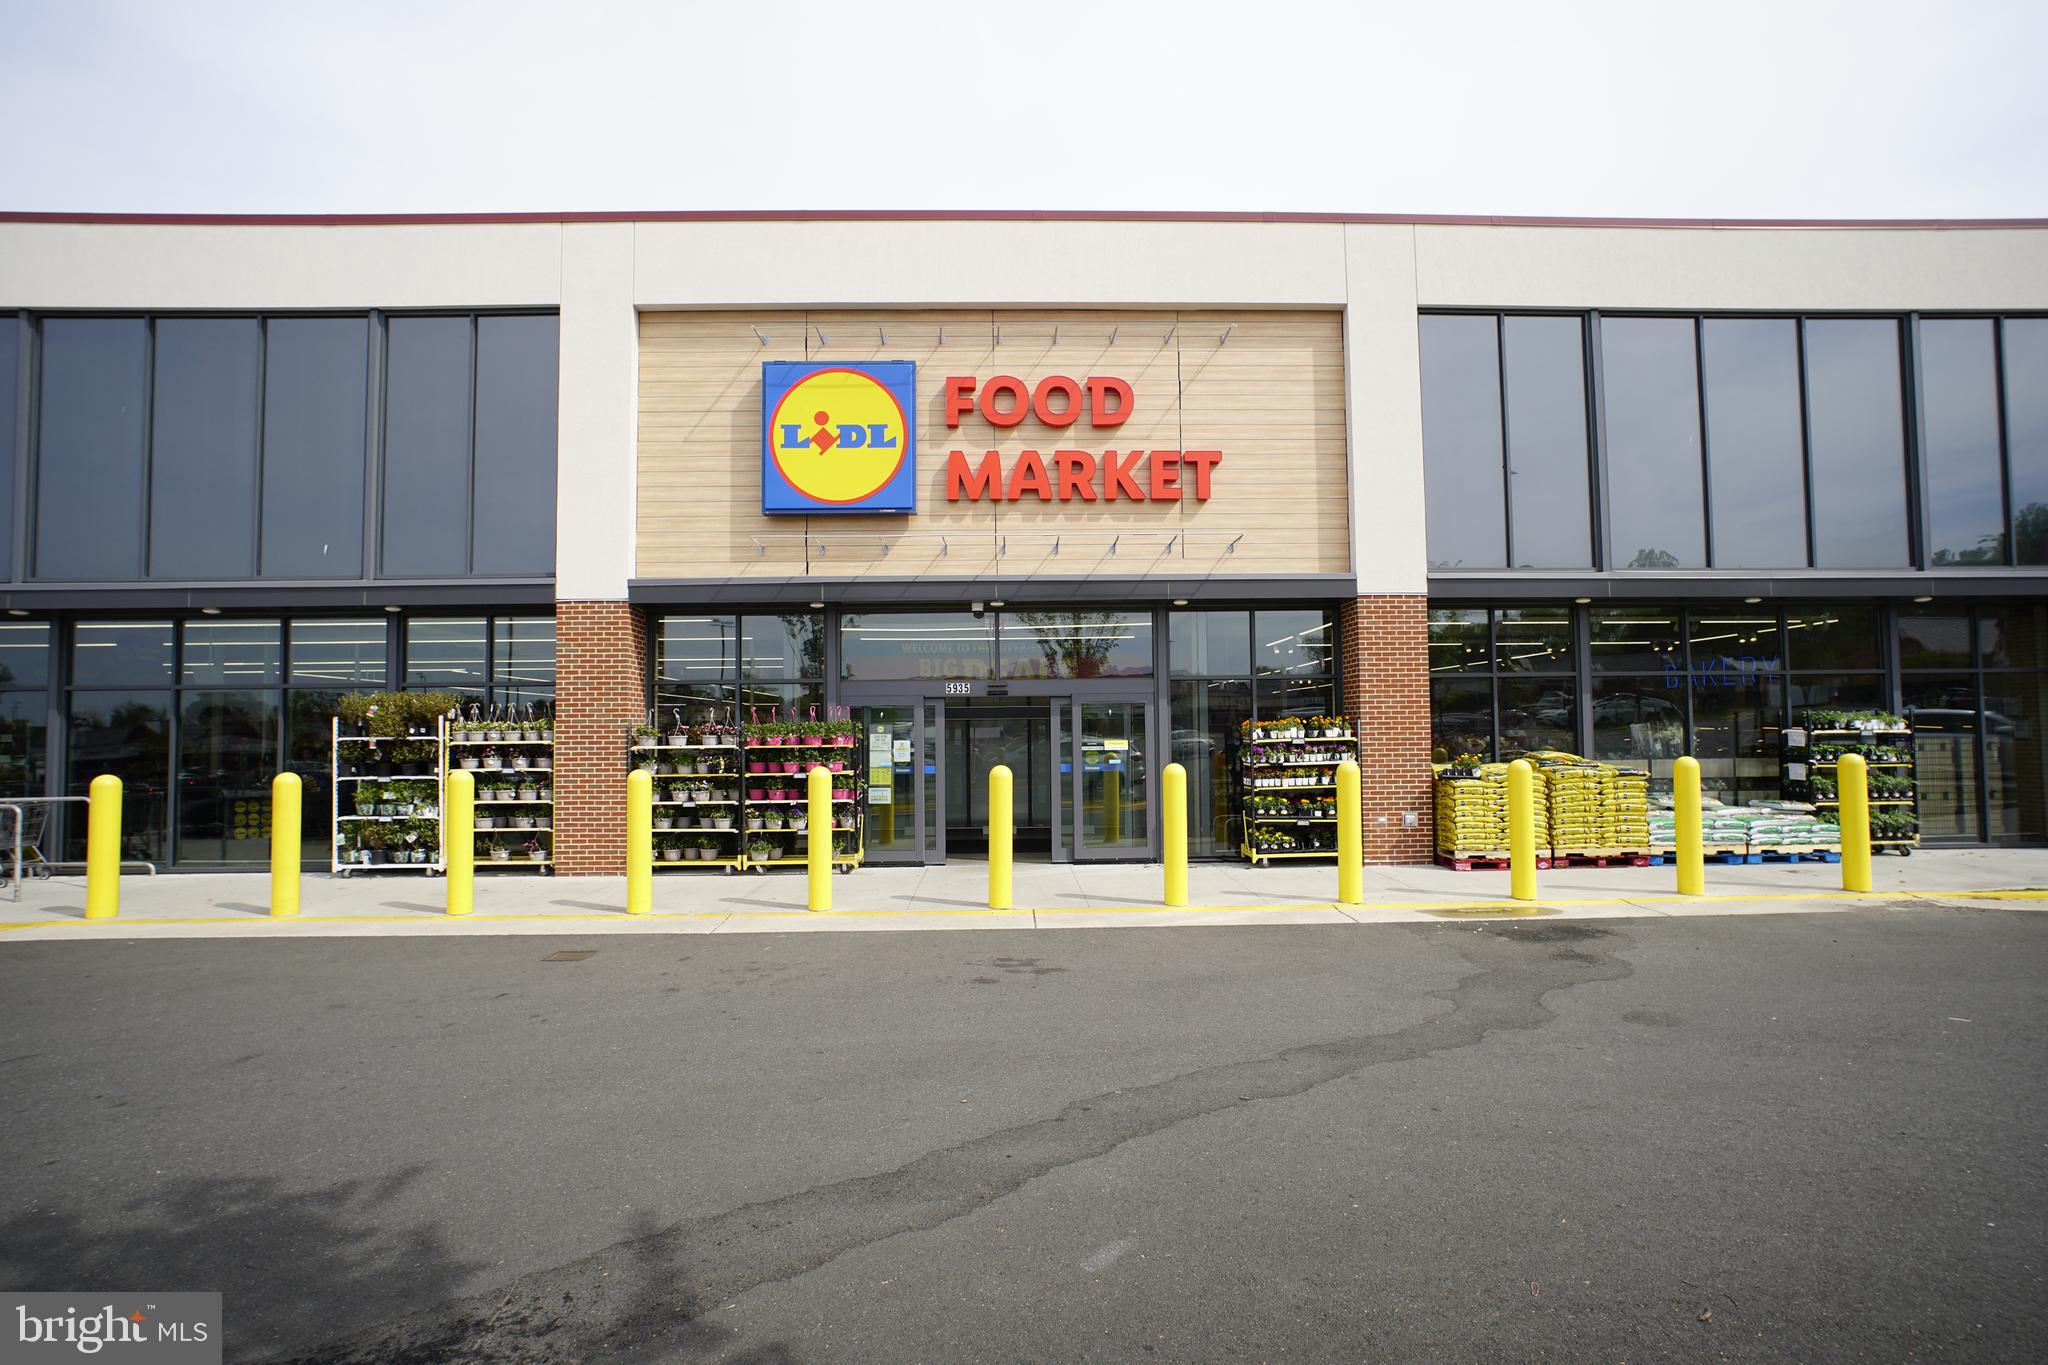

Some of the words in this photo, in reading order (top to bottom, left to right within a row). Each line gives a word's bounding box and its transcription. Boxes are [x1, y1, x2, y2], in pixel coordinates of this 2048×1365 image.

[946, 376, 1134, 429] FOOD
[947, 450, 1222, 502] MARKET
[902, 642, 953, 653] WELCOME
[918, 657, 959, 677] BIG
[1663, 655, 1778, 689] BAKERY
[946, 683, 969, 693] 5935
